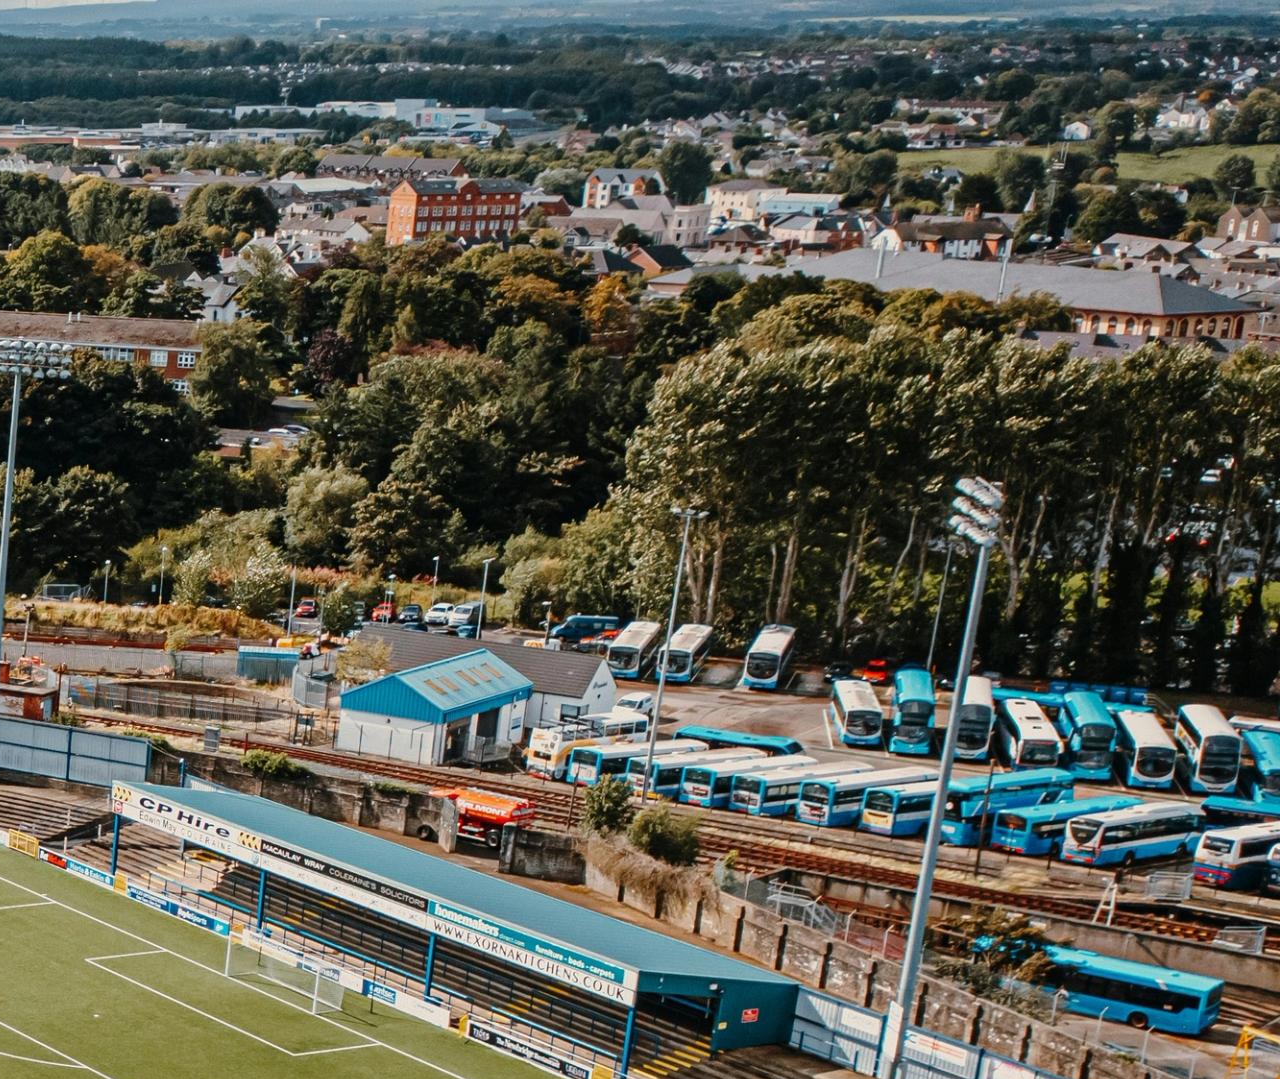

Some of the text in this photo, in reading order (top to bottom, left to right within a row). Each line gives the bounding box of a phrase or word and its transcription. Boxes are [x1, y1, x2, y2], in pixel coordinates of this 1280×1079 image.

[139, 797, 231, 838] CP Hire
[139, 810, 232, 854] Edwin May COERAINE
[262, 843, 426, 909] MACAULAY WRAY COLERAINE'S SOLICITORS
[433, 919, 626, 1002] WWW.EXORNAKITCHENS.CO.UK
[435, 903, 500, 938] homemakers
[535, 944, 564, 962] furniture
[568, 955, 585, 970] beds
[589, 965, 616, 983] carpets
